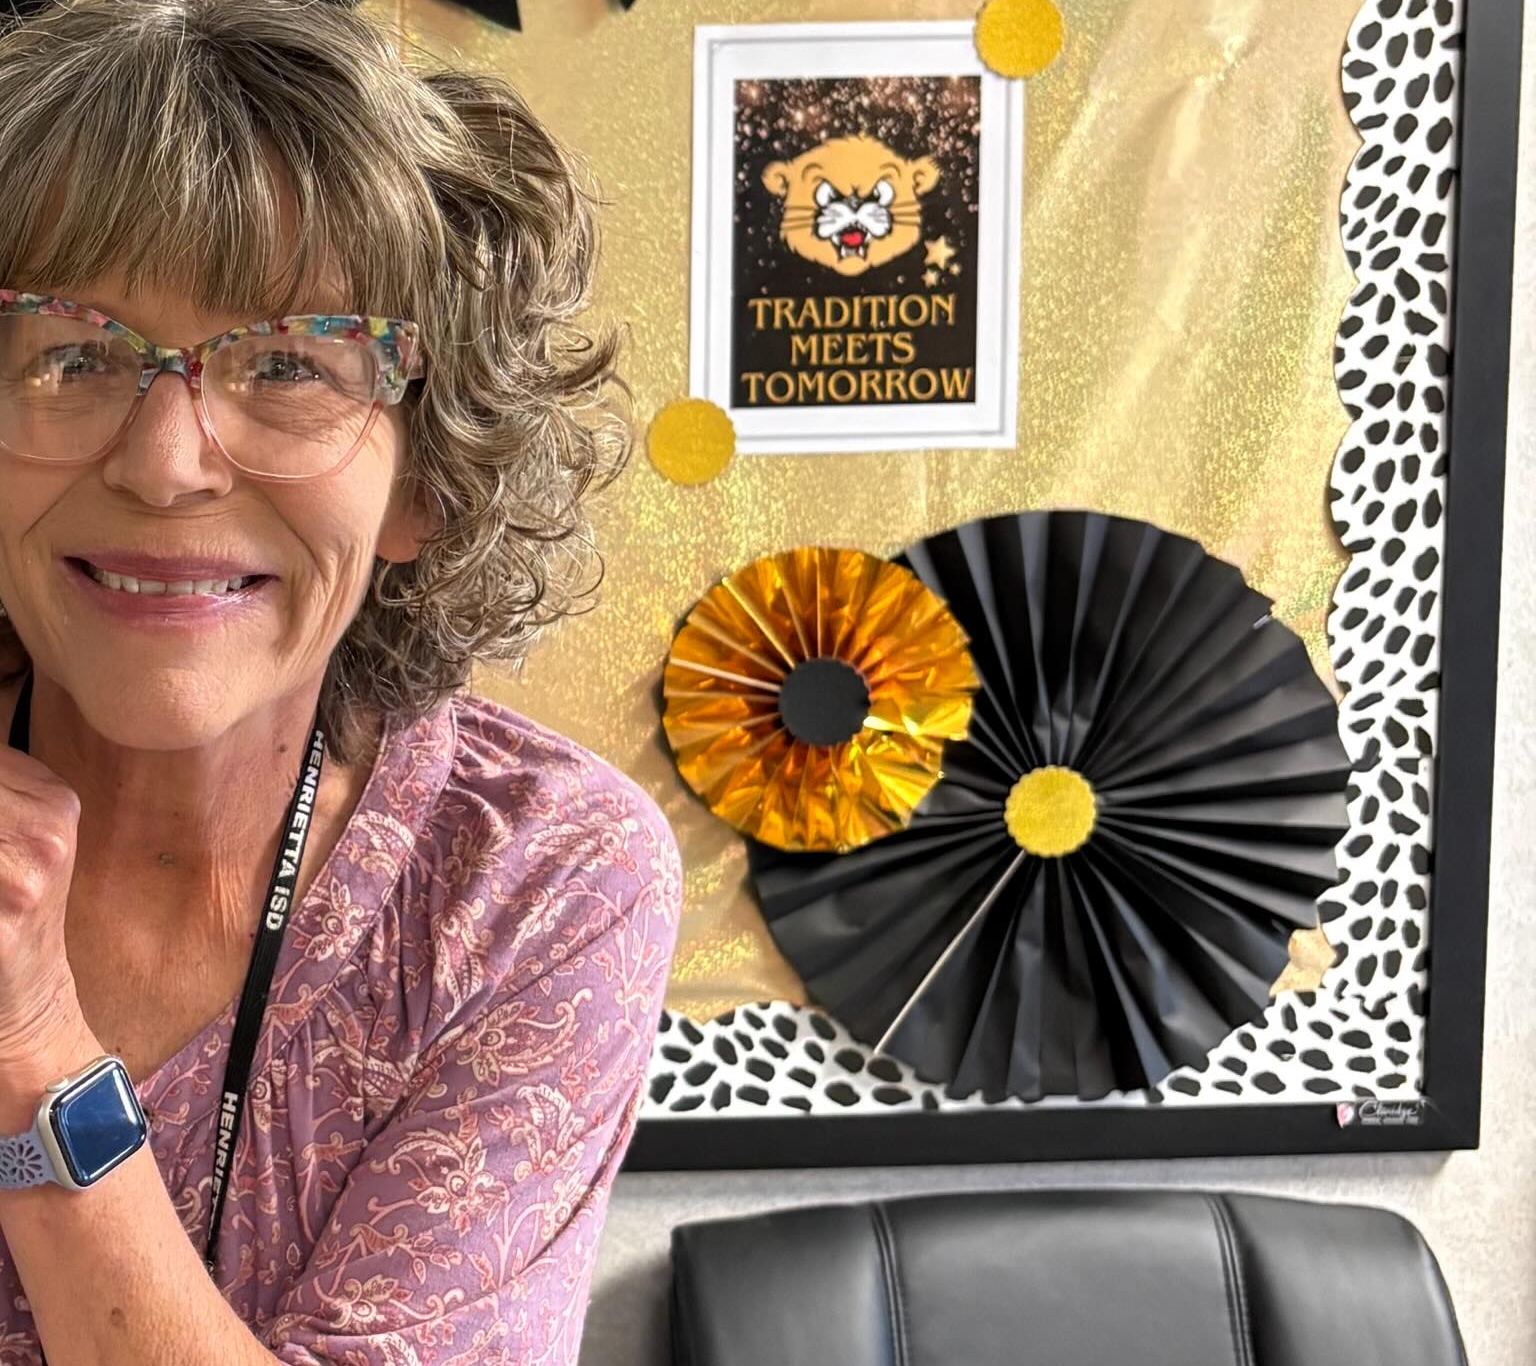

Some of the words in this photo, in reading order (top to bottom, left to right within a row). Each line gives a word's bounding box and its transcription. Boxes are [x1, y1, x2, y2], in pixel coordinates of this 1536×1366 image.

[748, 294, 956, 330] TRADITION
[790, 332, 916, 365] MEETS
[741, 368, 973, 403] TOMORROW
[279, 730, 324, 878] HENRIETTA
[266, 885, 291, 931] ISD
